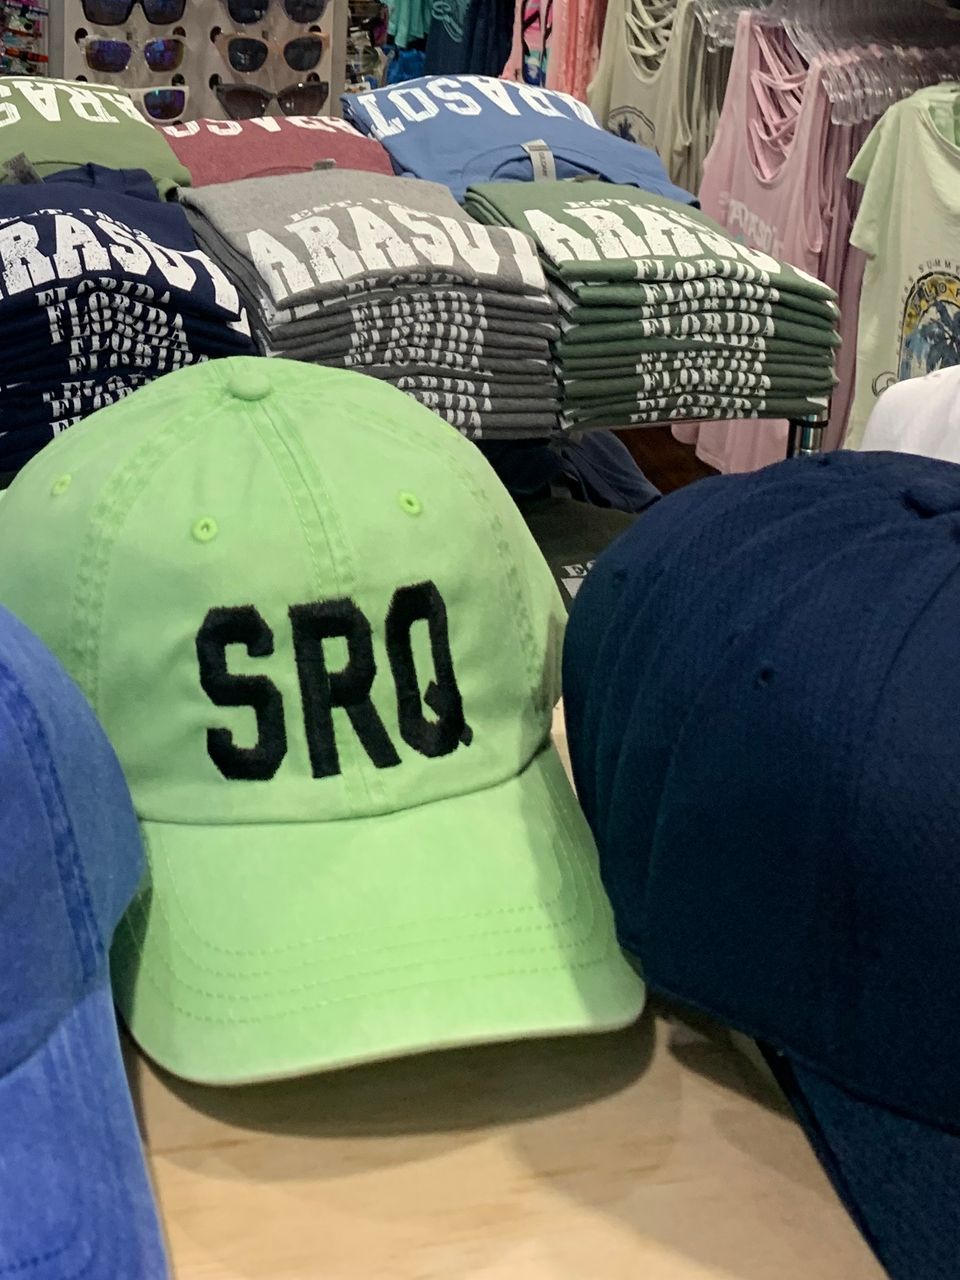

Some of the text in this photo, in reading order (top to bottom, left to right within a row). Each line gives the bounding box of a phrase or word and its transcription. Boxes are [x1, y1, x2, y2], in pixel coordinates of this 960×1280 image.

[634, 258, 771, 286] FLORIDA
[641, 276, 780, 305] FLORIDA
[641, 312, 775, 338] FLORIDA
[195, 579, 475, 782] SRQ
